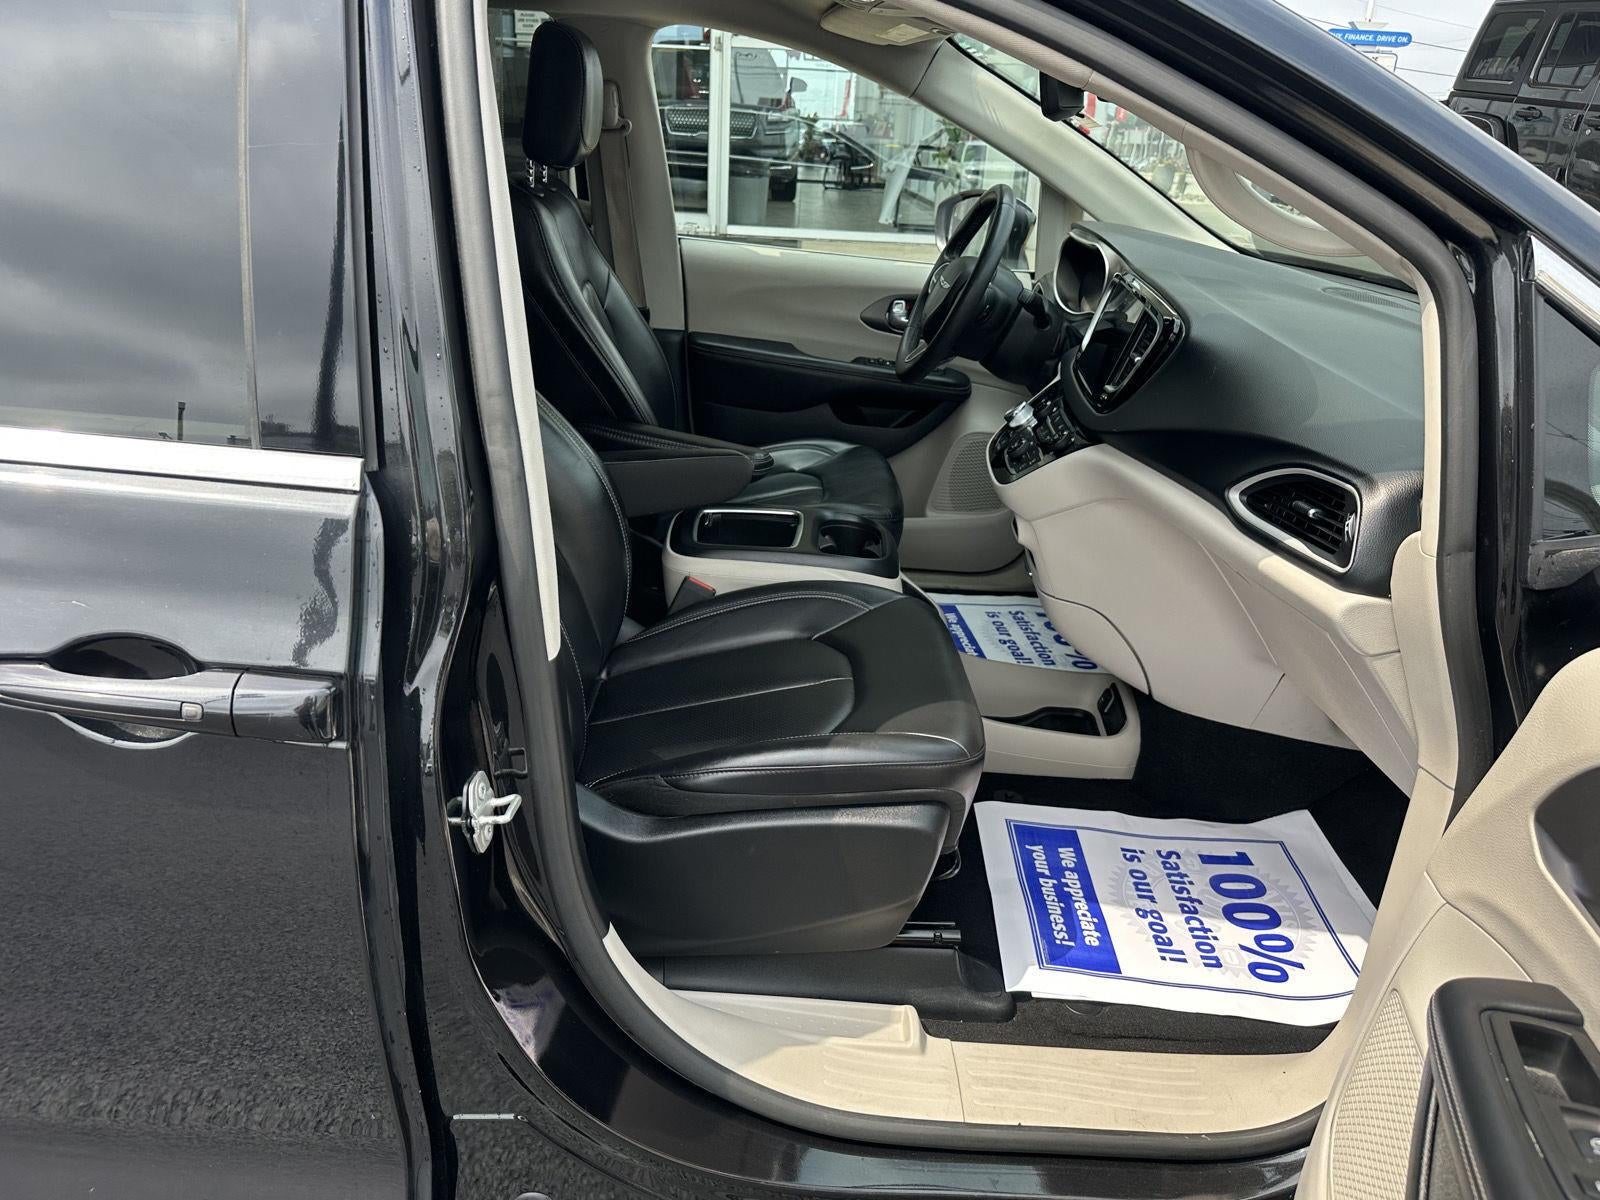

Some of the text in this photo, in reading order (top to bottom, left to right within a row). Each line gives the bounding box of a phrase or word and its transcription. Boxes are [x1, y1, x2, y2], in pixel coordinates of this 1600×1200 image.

[1344, 33, 1374, 41] FINANCE.
[1376, 34, 1396, 42] DRIVE
[985, 611, 1035, 665] is our goal!
[1009, 610, 1056, 666] Satisfaction
[1025, 844, 1076, 947] your business!
[1058, 847, 1101, 947] We appreciate
[1120, 847, 1188, 964] is our goal!
[1156, 850, 1223, 968] Satisfaction
[1198, 851, 1305, 983] 100%
